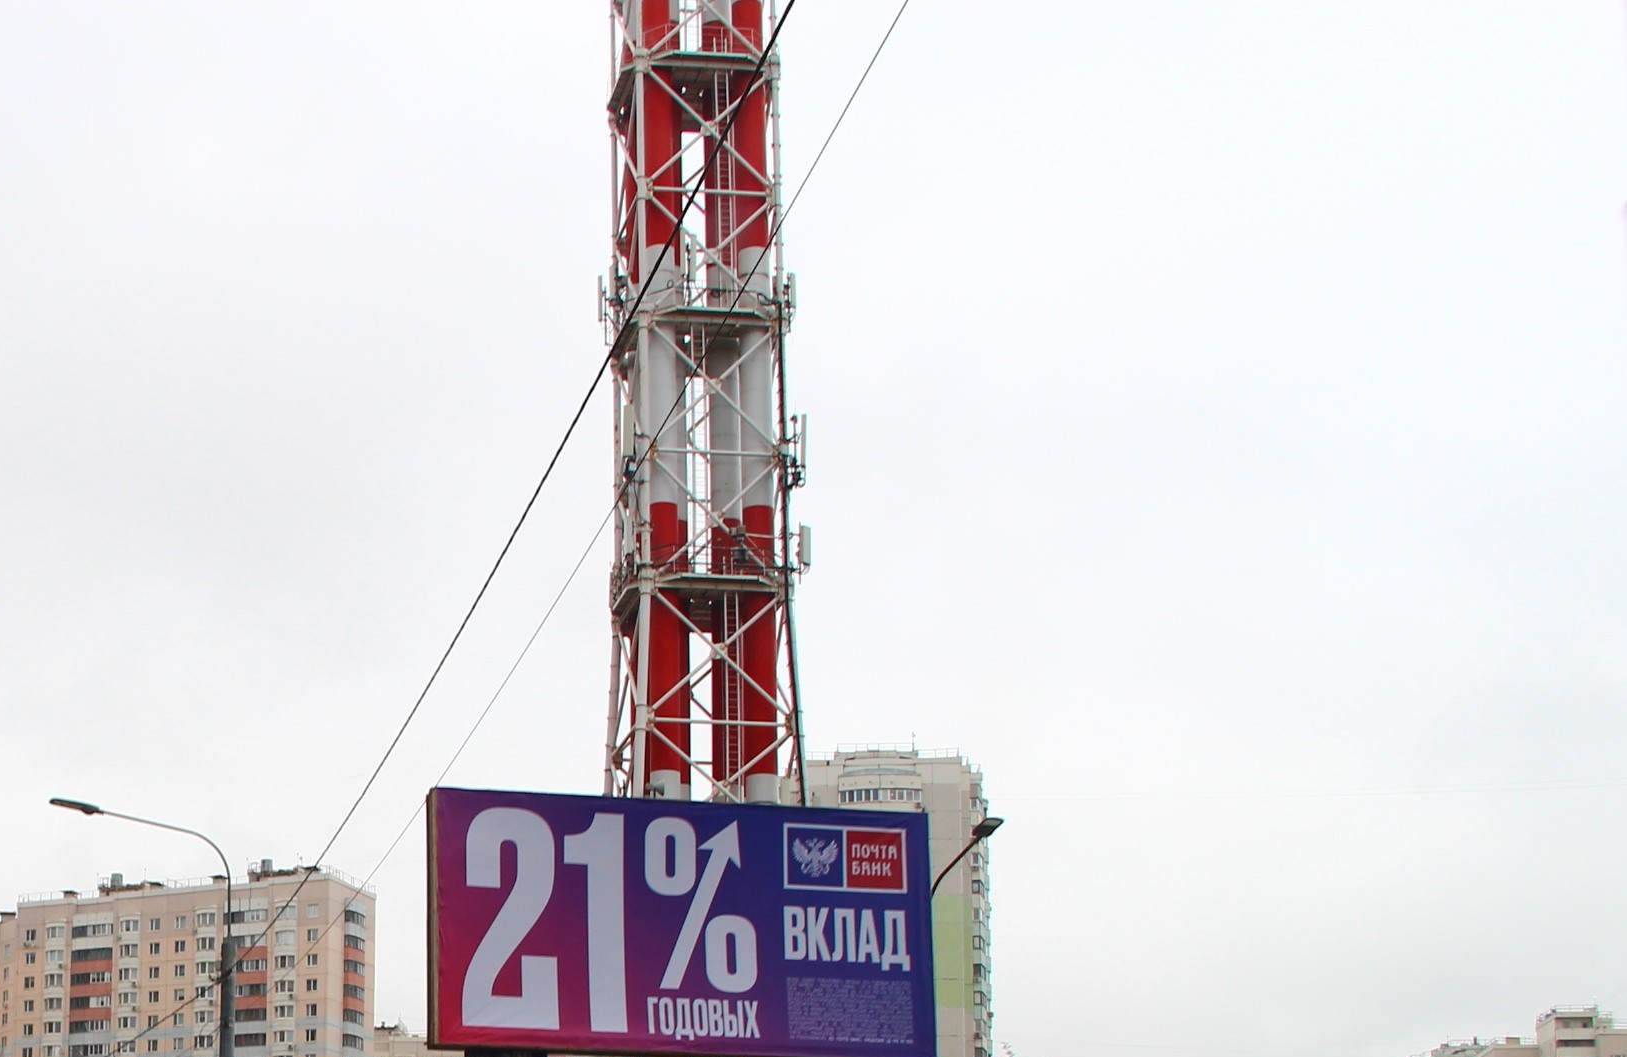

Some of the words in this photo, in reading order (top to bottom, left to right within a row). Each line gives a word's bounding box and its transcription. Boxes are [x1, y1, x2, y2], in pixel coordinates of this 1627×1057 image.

[851, 843, 898, 861] ПОЧТА
[851, 861, 893, 877] БАНК
[783, 905, 911, 972] ВКЛАД
[647, 996, 761, 1041] ГОДОВЫХ
